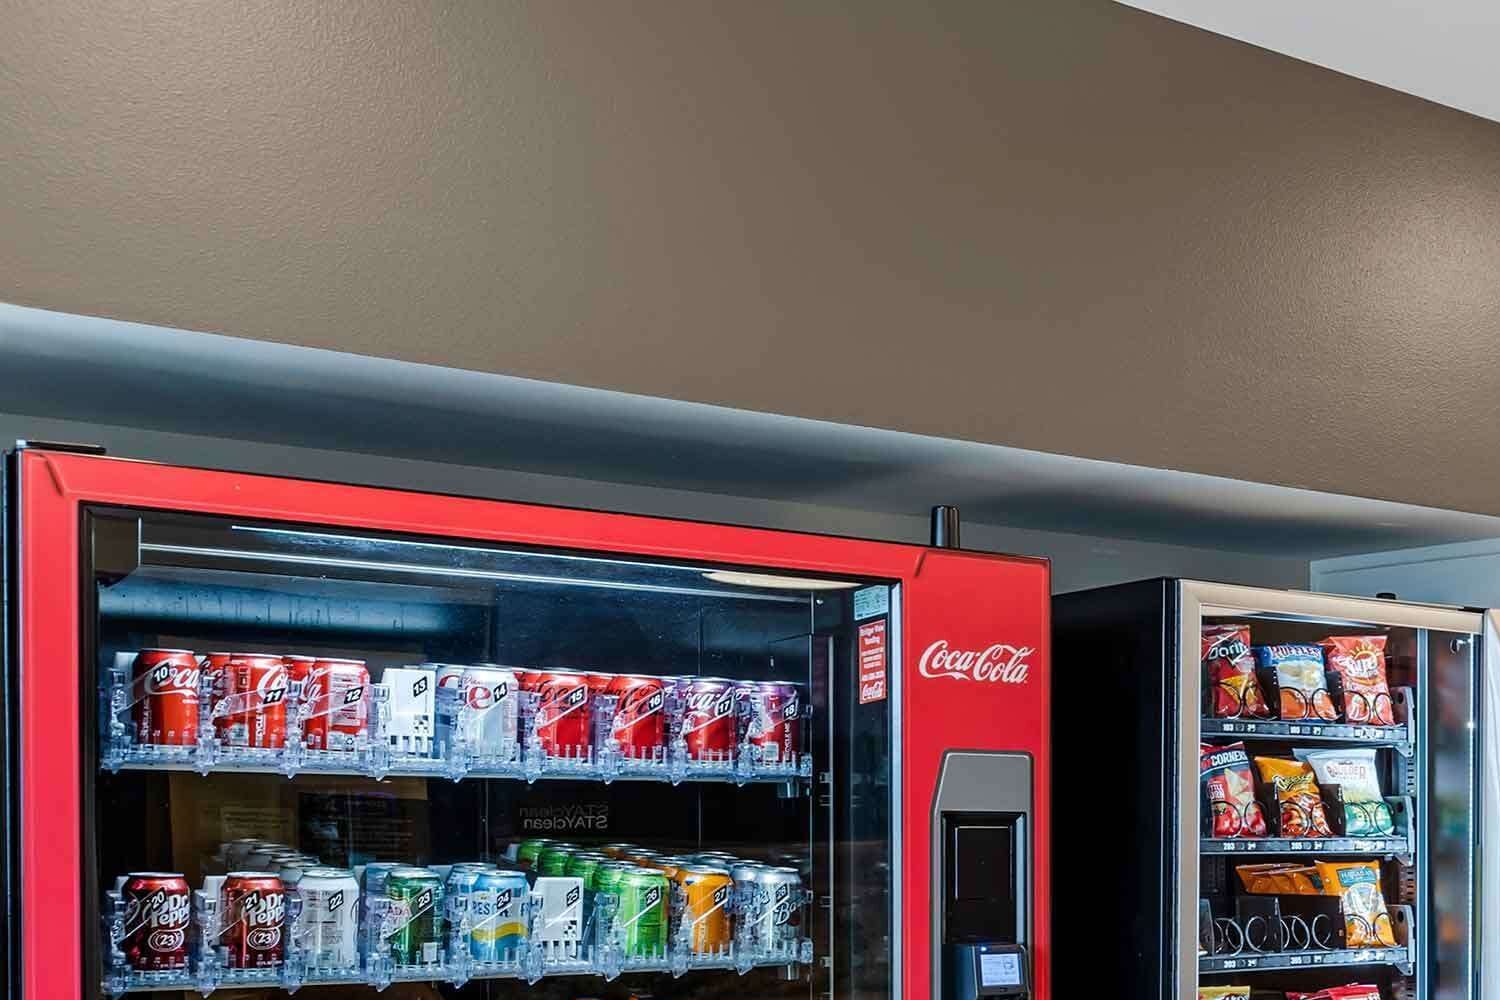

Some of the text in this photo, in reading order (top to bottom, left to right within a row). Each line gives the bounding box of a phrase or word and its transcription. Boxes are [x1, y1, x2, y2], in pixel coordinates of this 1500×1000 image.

[919, 640, 1036, 684] Coca-Cola
[153, 665, 168, 683] 10
[265, 688, 285, 704] 11
[346, 688, 362, 703] 12
[413, 681, 428, 698] 13
[494, 685, 508, 703] 14
[570, 691, 583, 704] 15
[649, 693, 661, 708] 16
[718, 699, 730, 714] 17
[784, 702, 795, 717] 18
[151, 892, 164, 908] 20
[168, 894, 189, 910] Dr
[246, 893, 258, 908] 21
[266, 893, 285, 910] Dr
[330, 894, 343, 910] 22
[418, 892, 430, 908] 23
[497, 891, 510, 907] 24
[567, 888, 579, 904] 25
[647, 889, 658, 904] 26
[714, 887, 726, 903] 27
[160, 931, 175, 945] 23
[257, 931, 272, 944] 23
